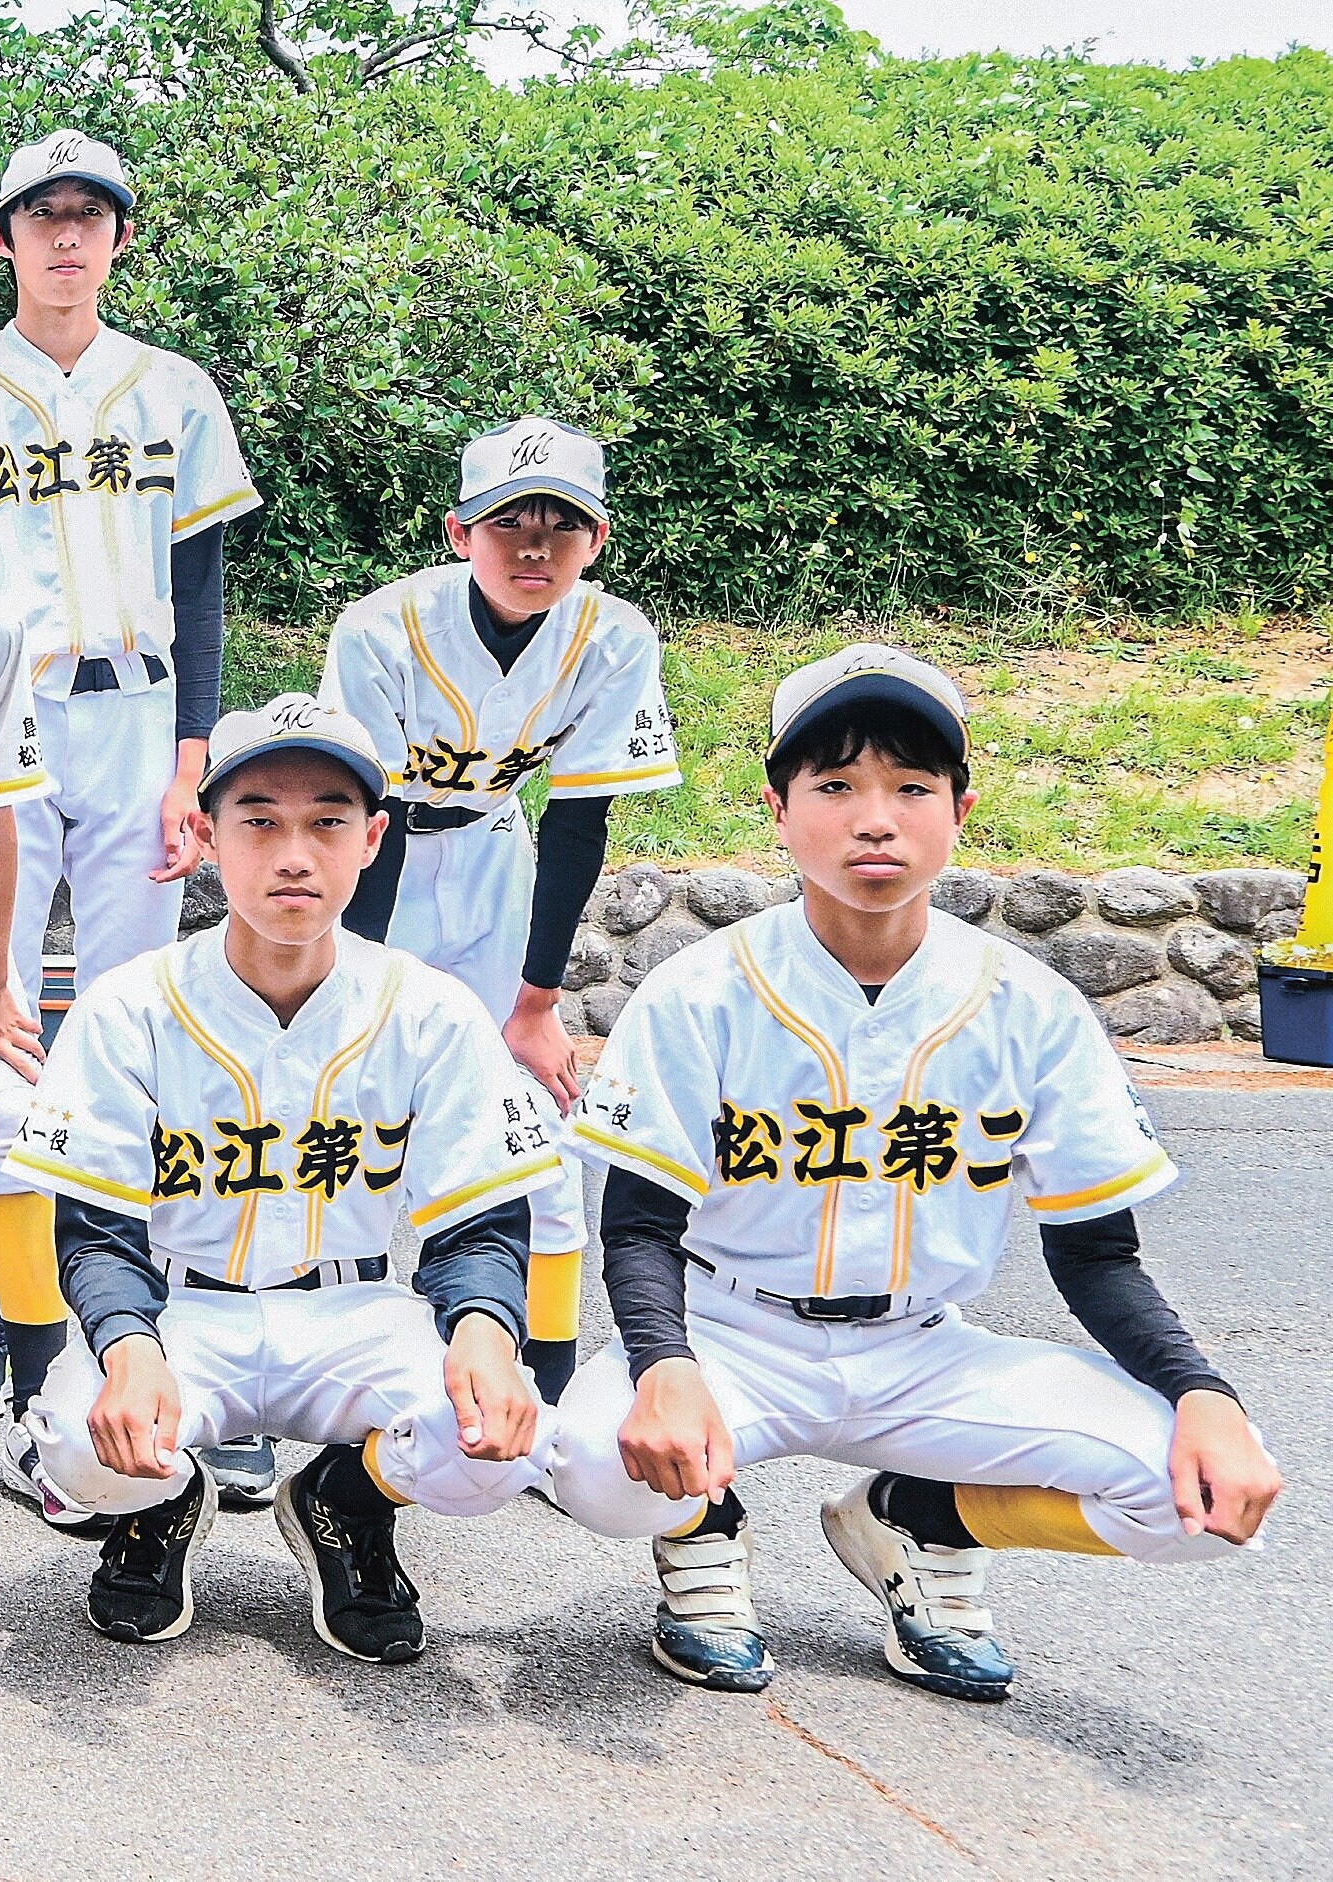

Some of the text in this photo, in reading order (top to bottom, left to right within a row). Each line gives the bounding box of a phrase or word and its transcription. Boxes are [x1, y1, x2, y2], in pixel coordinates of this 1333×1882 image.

[16, 1117, 69, 1155] 人一役
[151, 1117, 411, 1199] 松江第二
[715, 1101, 1026, 1192] 松江第二
